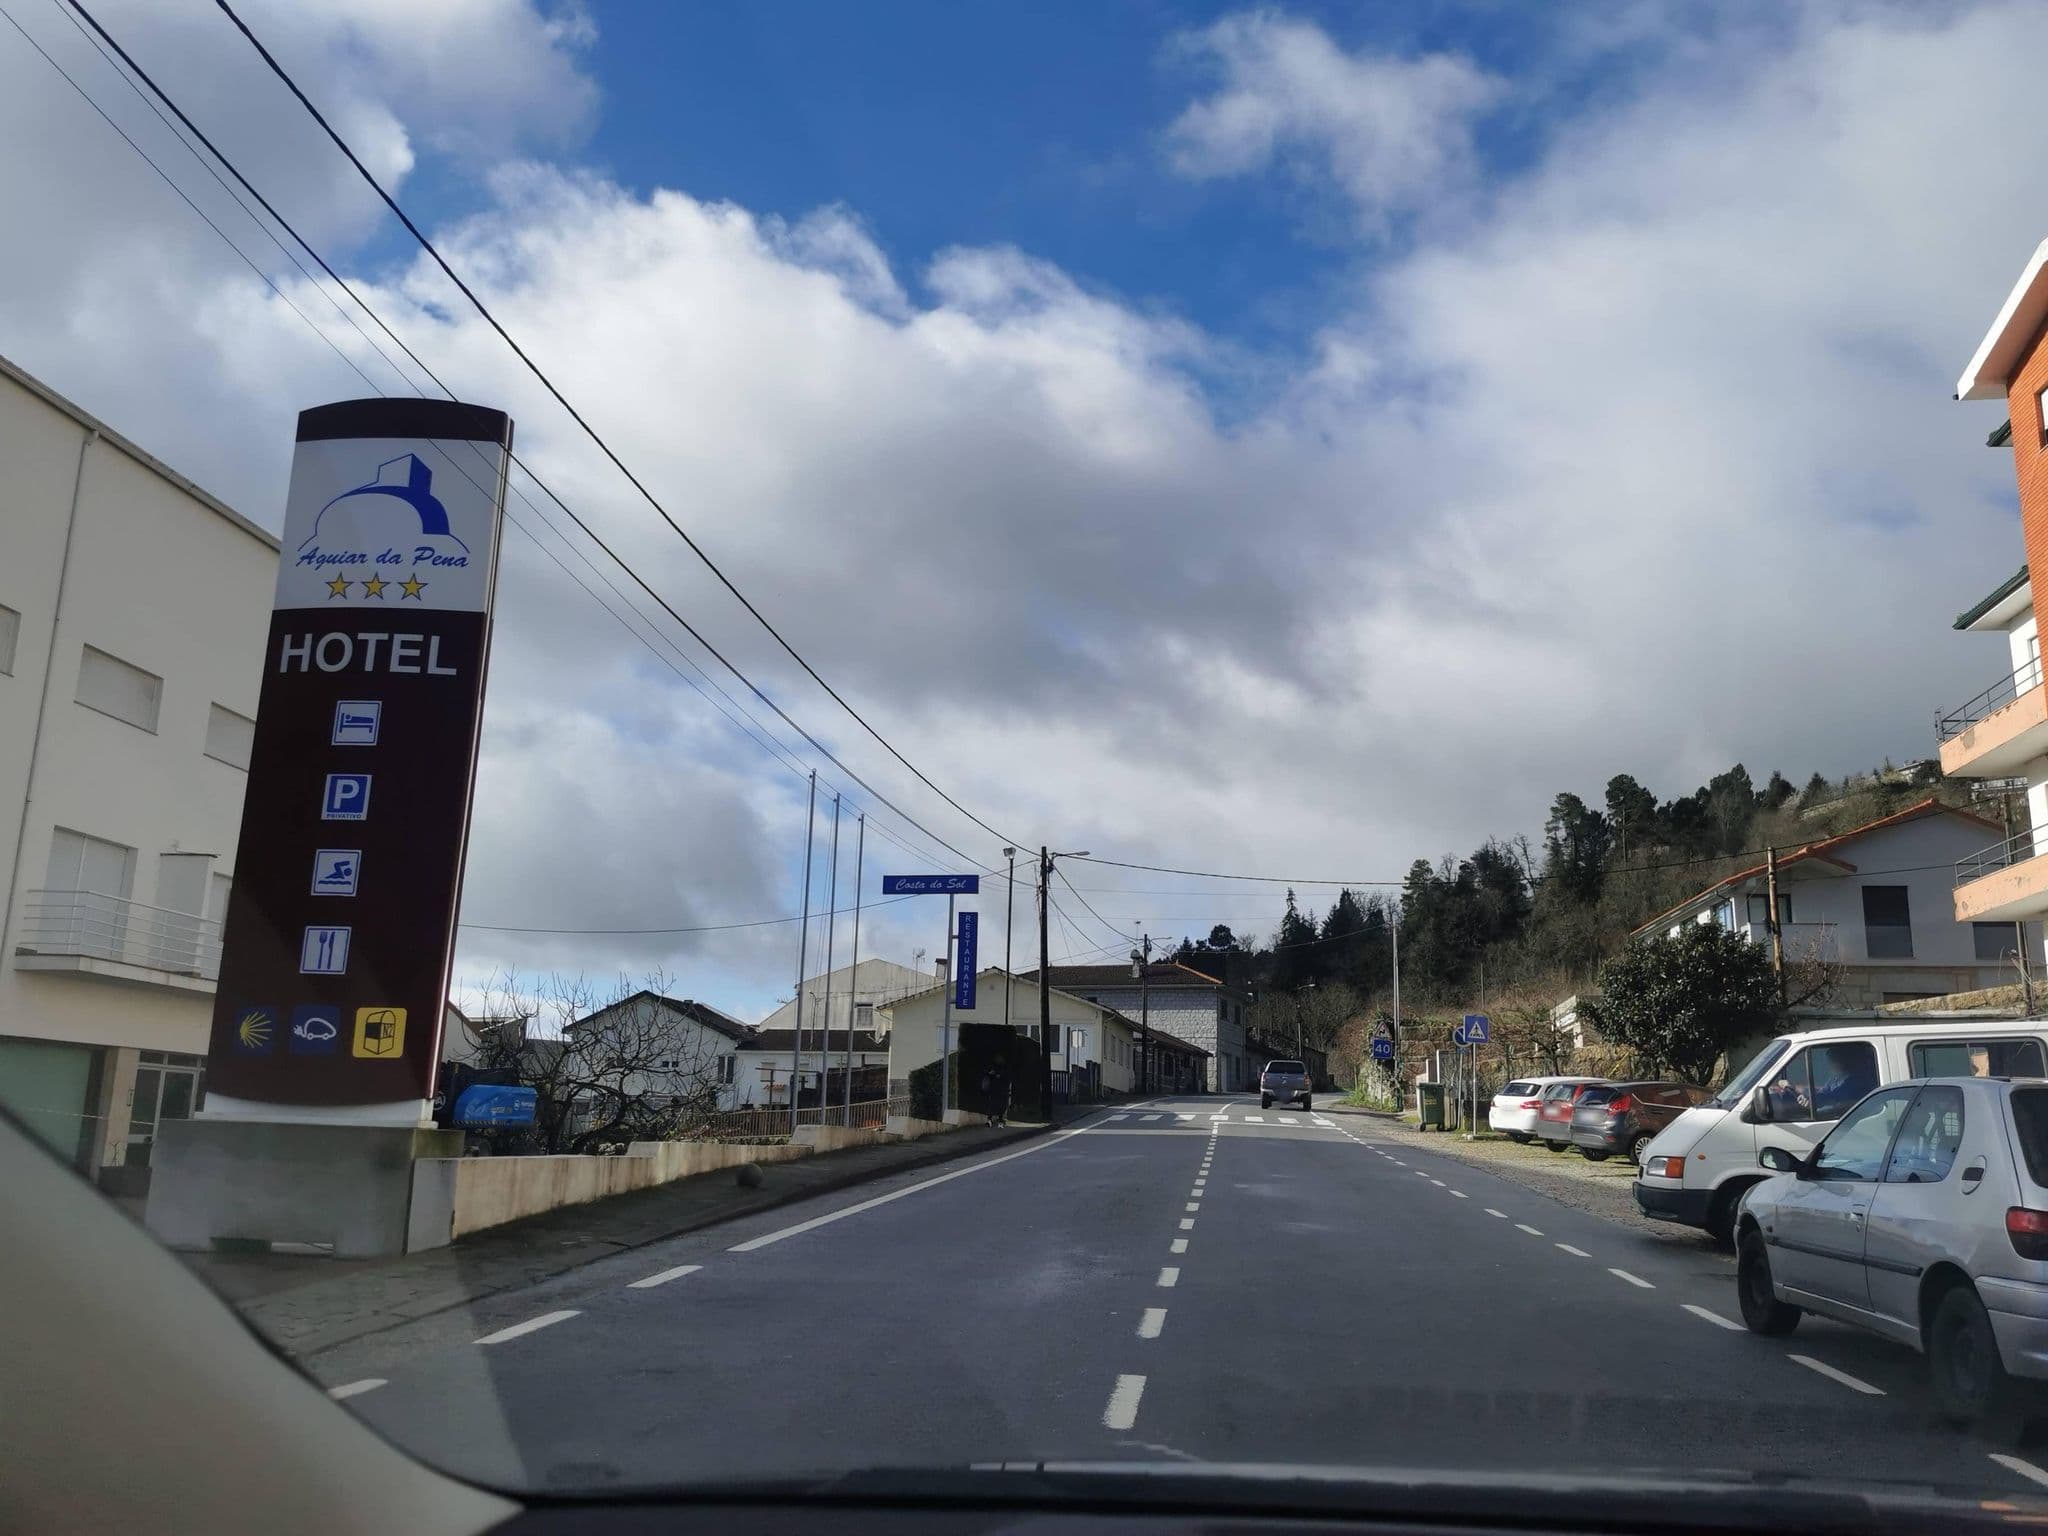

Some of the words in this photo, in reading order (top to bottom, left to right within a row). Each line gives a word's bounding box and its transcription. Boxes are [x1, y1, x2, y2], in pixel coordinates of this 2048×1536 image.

[296, 546, 368, 571] Aguiar
[376, 548, 403, 565] da
[412, 546, 469, 568] Pena
[279, 632, 457, 676] HOTEL
[333, 779, 360, 809] P
[895, 879, 926, 891] Costa
[929, 879, 942, 889] do
[946, 878, 967, 889] Sol
[962, 915, 971, 1006] RESTAURANTE
[1375, 1044, 1390, 1054] 40
